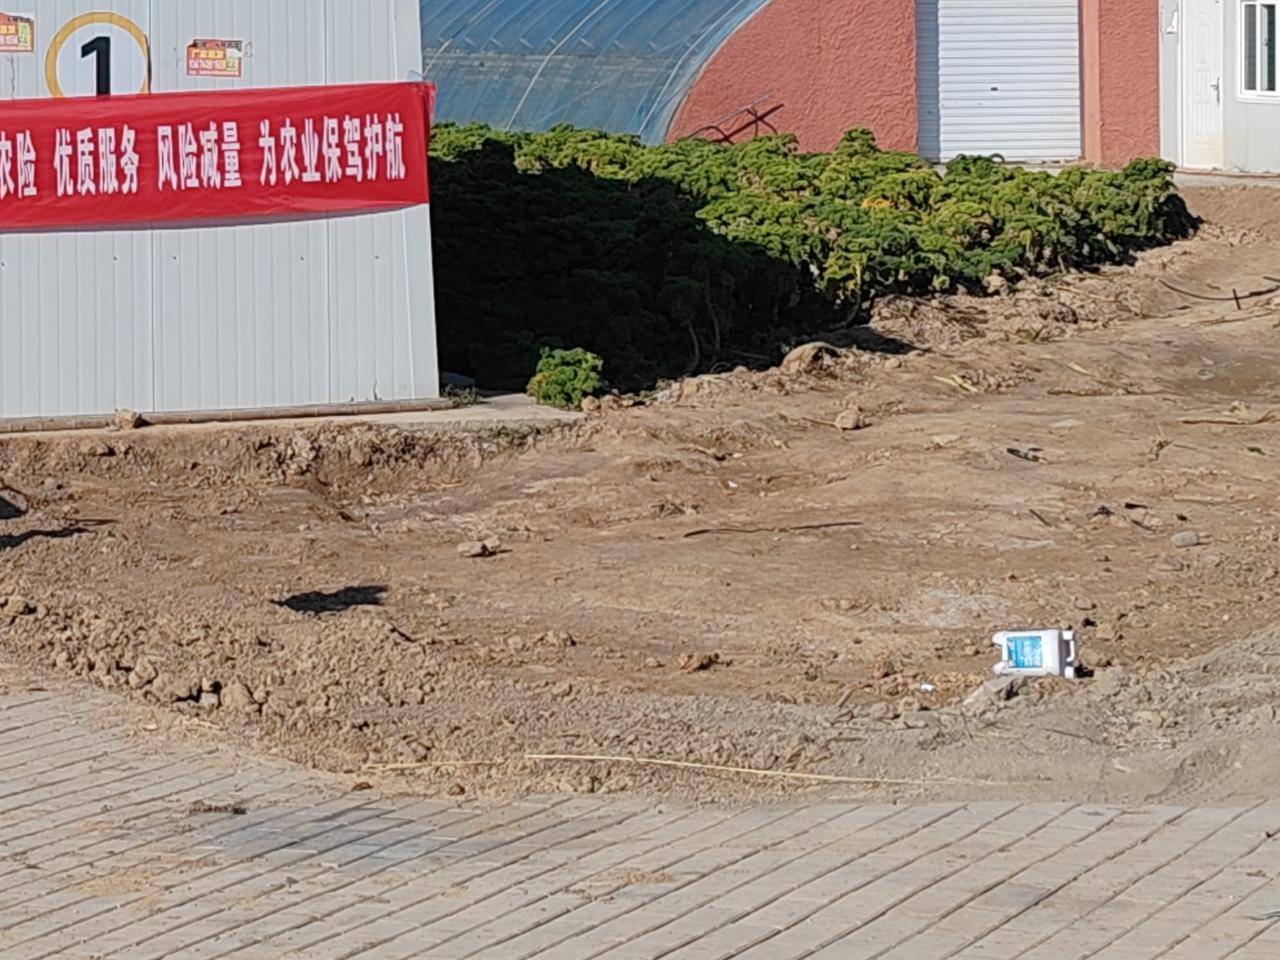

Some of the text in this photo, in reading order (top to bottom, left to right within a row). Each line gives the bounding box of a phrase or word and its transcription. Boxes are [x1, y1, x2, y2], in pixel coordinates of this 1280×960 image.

[80, 36, 111, 98] 1
[53, 123, 140, 196] 优质服务
[156, 120, 243, 191] 风险减量
[258, 112, 406, 186] 为农业保驾护航
